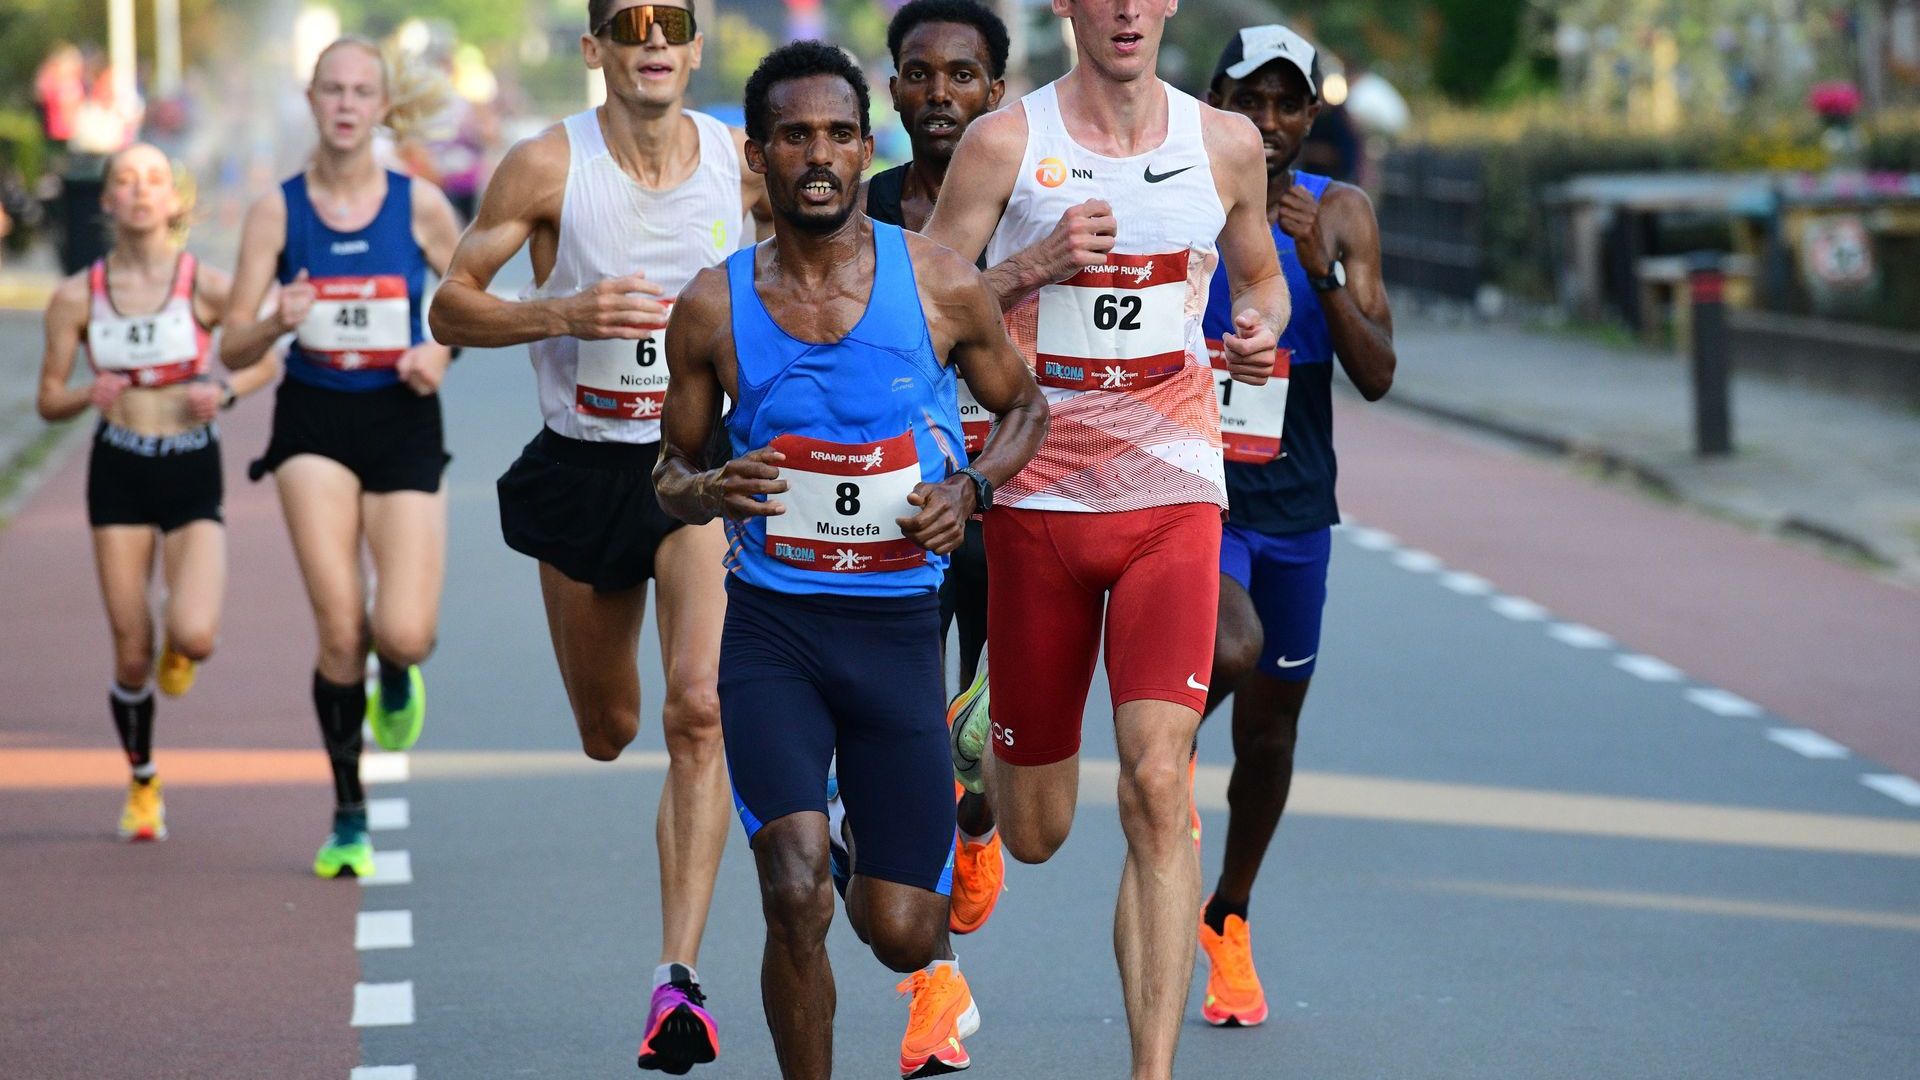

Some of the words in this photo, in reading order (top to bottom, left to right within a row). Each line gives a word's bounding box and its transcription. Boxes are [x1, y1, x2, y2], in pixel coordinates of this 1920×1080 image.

[1072, 168, 1093, 179] NN
[1084, 264, 1119, 274] KRAMP
[334, 306, 369, 328] 48
[1093, 293, 1142, 331] 62
[126, 322, 156, 344] 47
[636, 337, 657, 367] 6
[1045, 363, 1084, 379] DUCONA
[620, 374, 670, 386] Nicolas
[810, 450, 847, 463] KRAMP
[835, 482, 861, 516] 8
[816, 521, 880, 537] Mustefa
[775, 544, 815, 561] DUCONA
